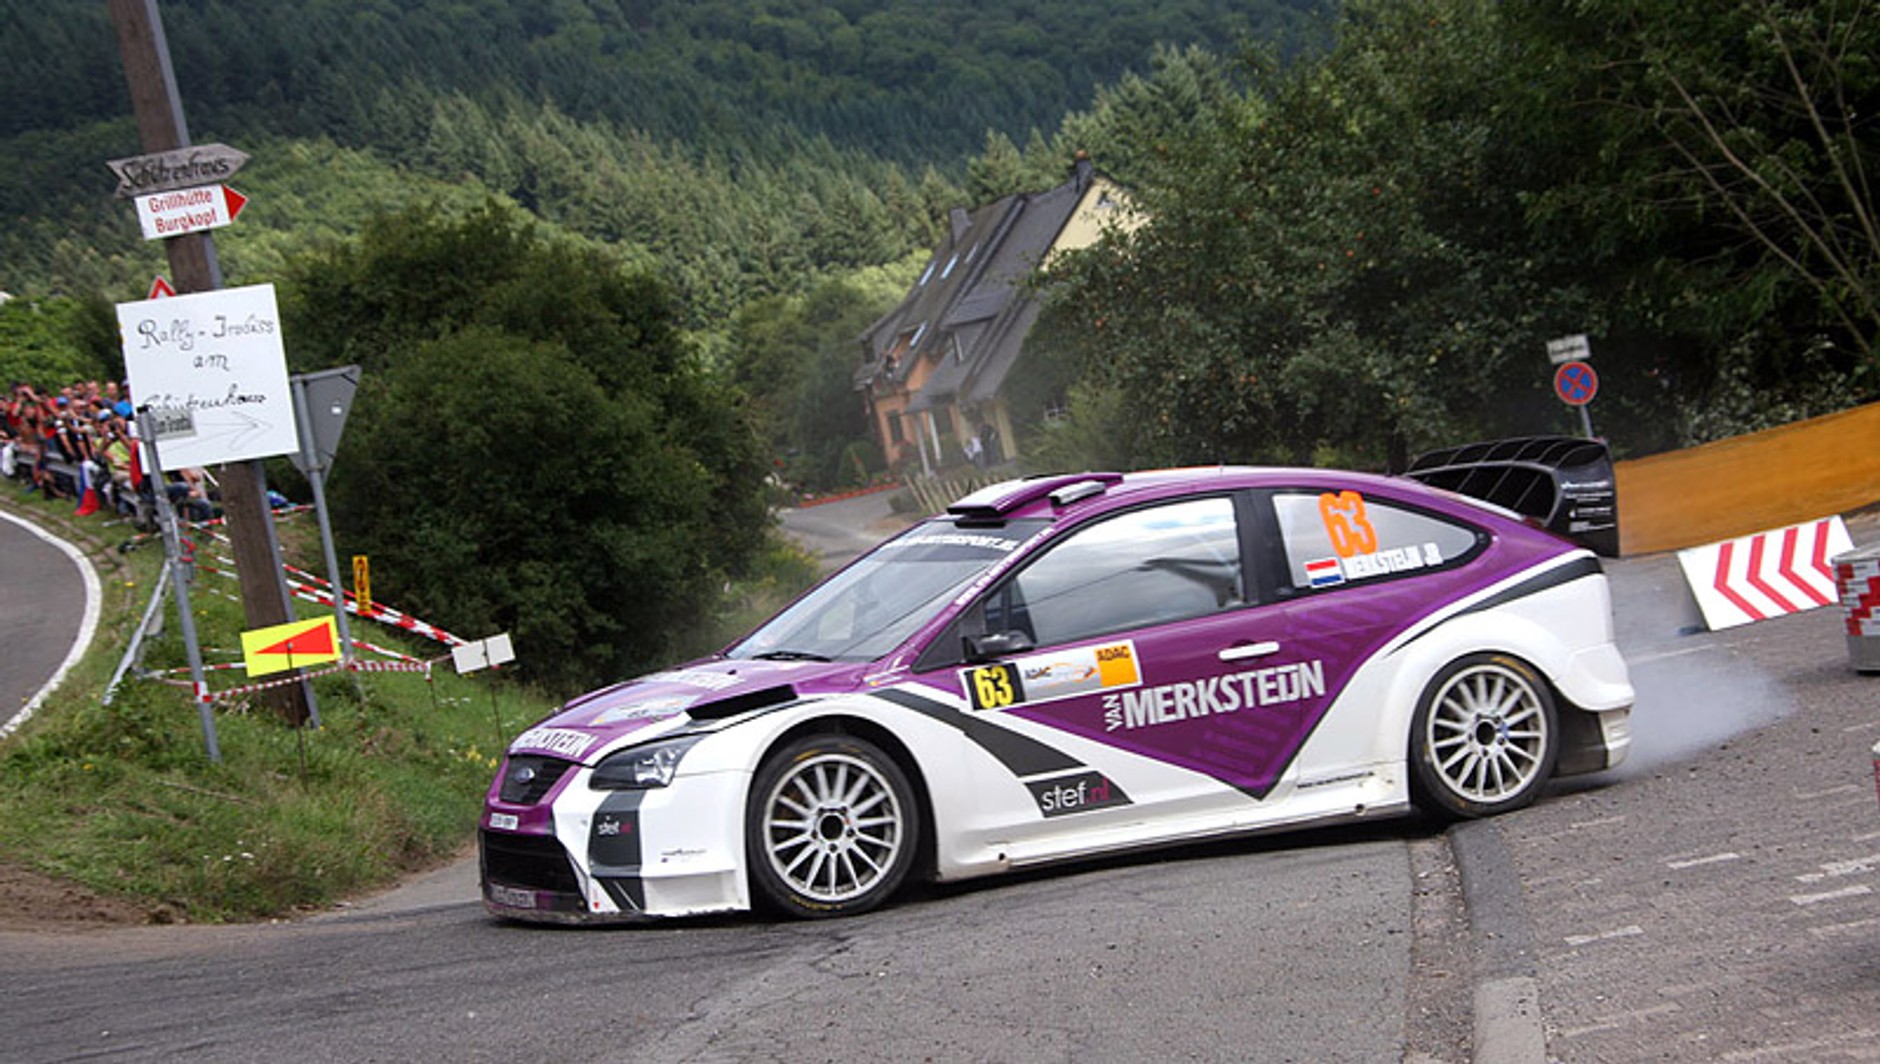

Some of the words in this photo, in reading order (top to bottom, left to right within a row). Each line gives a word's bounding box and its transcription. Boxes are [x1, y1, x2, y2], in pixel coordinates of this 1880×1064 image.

[148, 188, 213, 213] Grillhütte
[155, 208, 218, 234] Burgkopf
[193, 354, 230, 372] am
[1317, 490, 1379, 559] 63
[1096, 645, 1131, 661] ADAC
[972, 665, 1014, 710] 63
[1103, 693, 1125, 732] VAN
[1041, 778, 1110, 812] stef.nl
